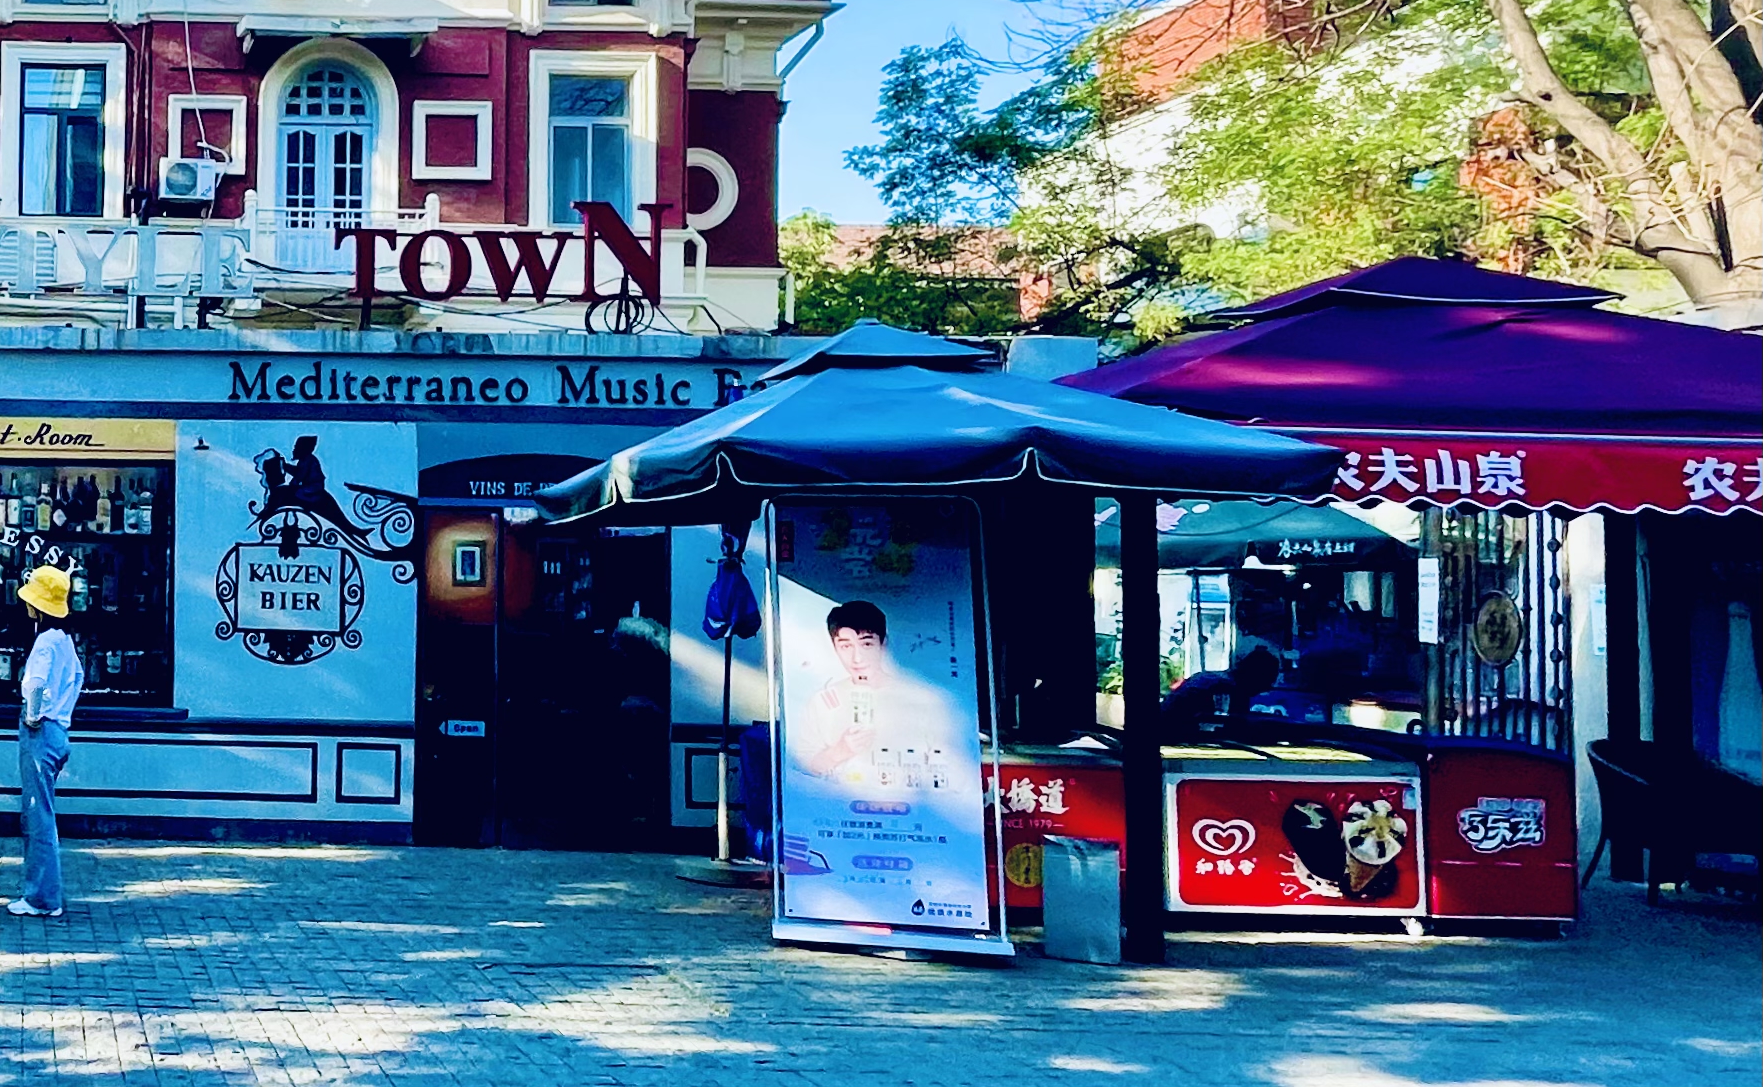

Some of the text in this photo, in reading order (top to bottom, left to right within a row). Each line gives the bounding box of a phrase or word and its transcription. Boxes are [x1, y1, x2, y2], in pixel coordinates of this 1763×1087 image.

[334, 201, 674, 305] TOWN
[228, 361, 530, 404] Mediterraneo
[556, 365, 692, 407] Music
[23, 422, 105, 447] Room
[469, 481, 505, 496] VINS
[513, 482, 533, 496] DE
[248, 562, 332, 586] KAUZEN
[260, 590, 322, 611] BIER
